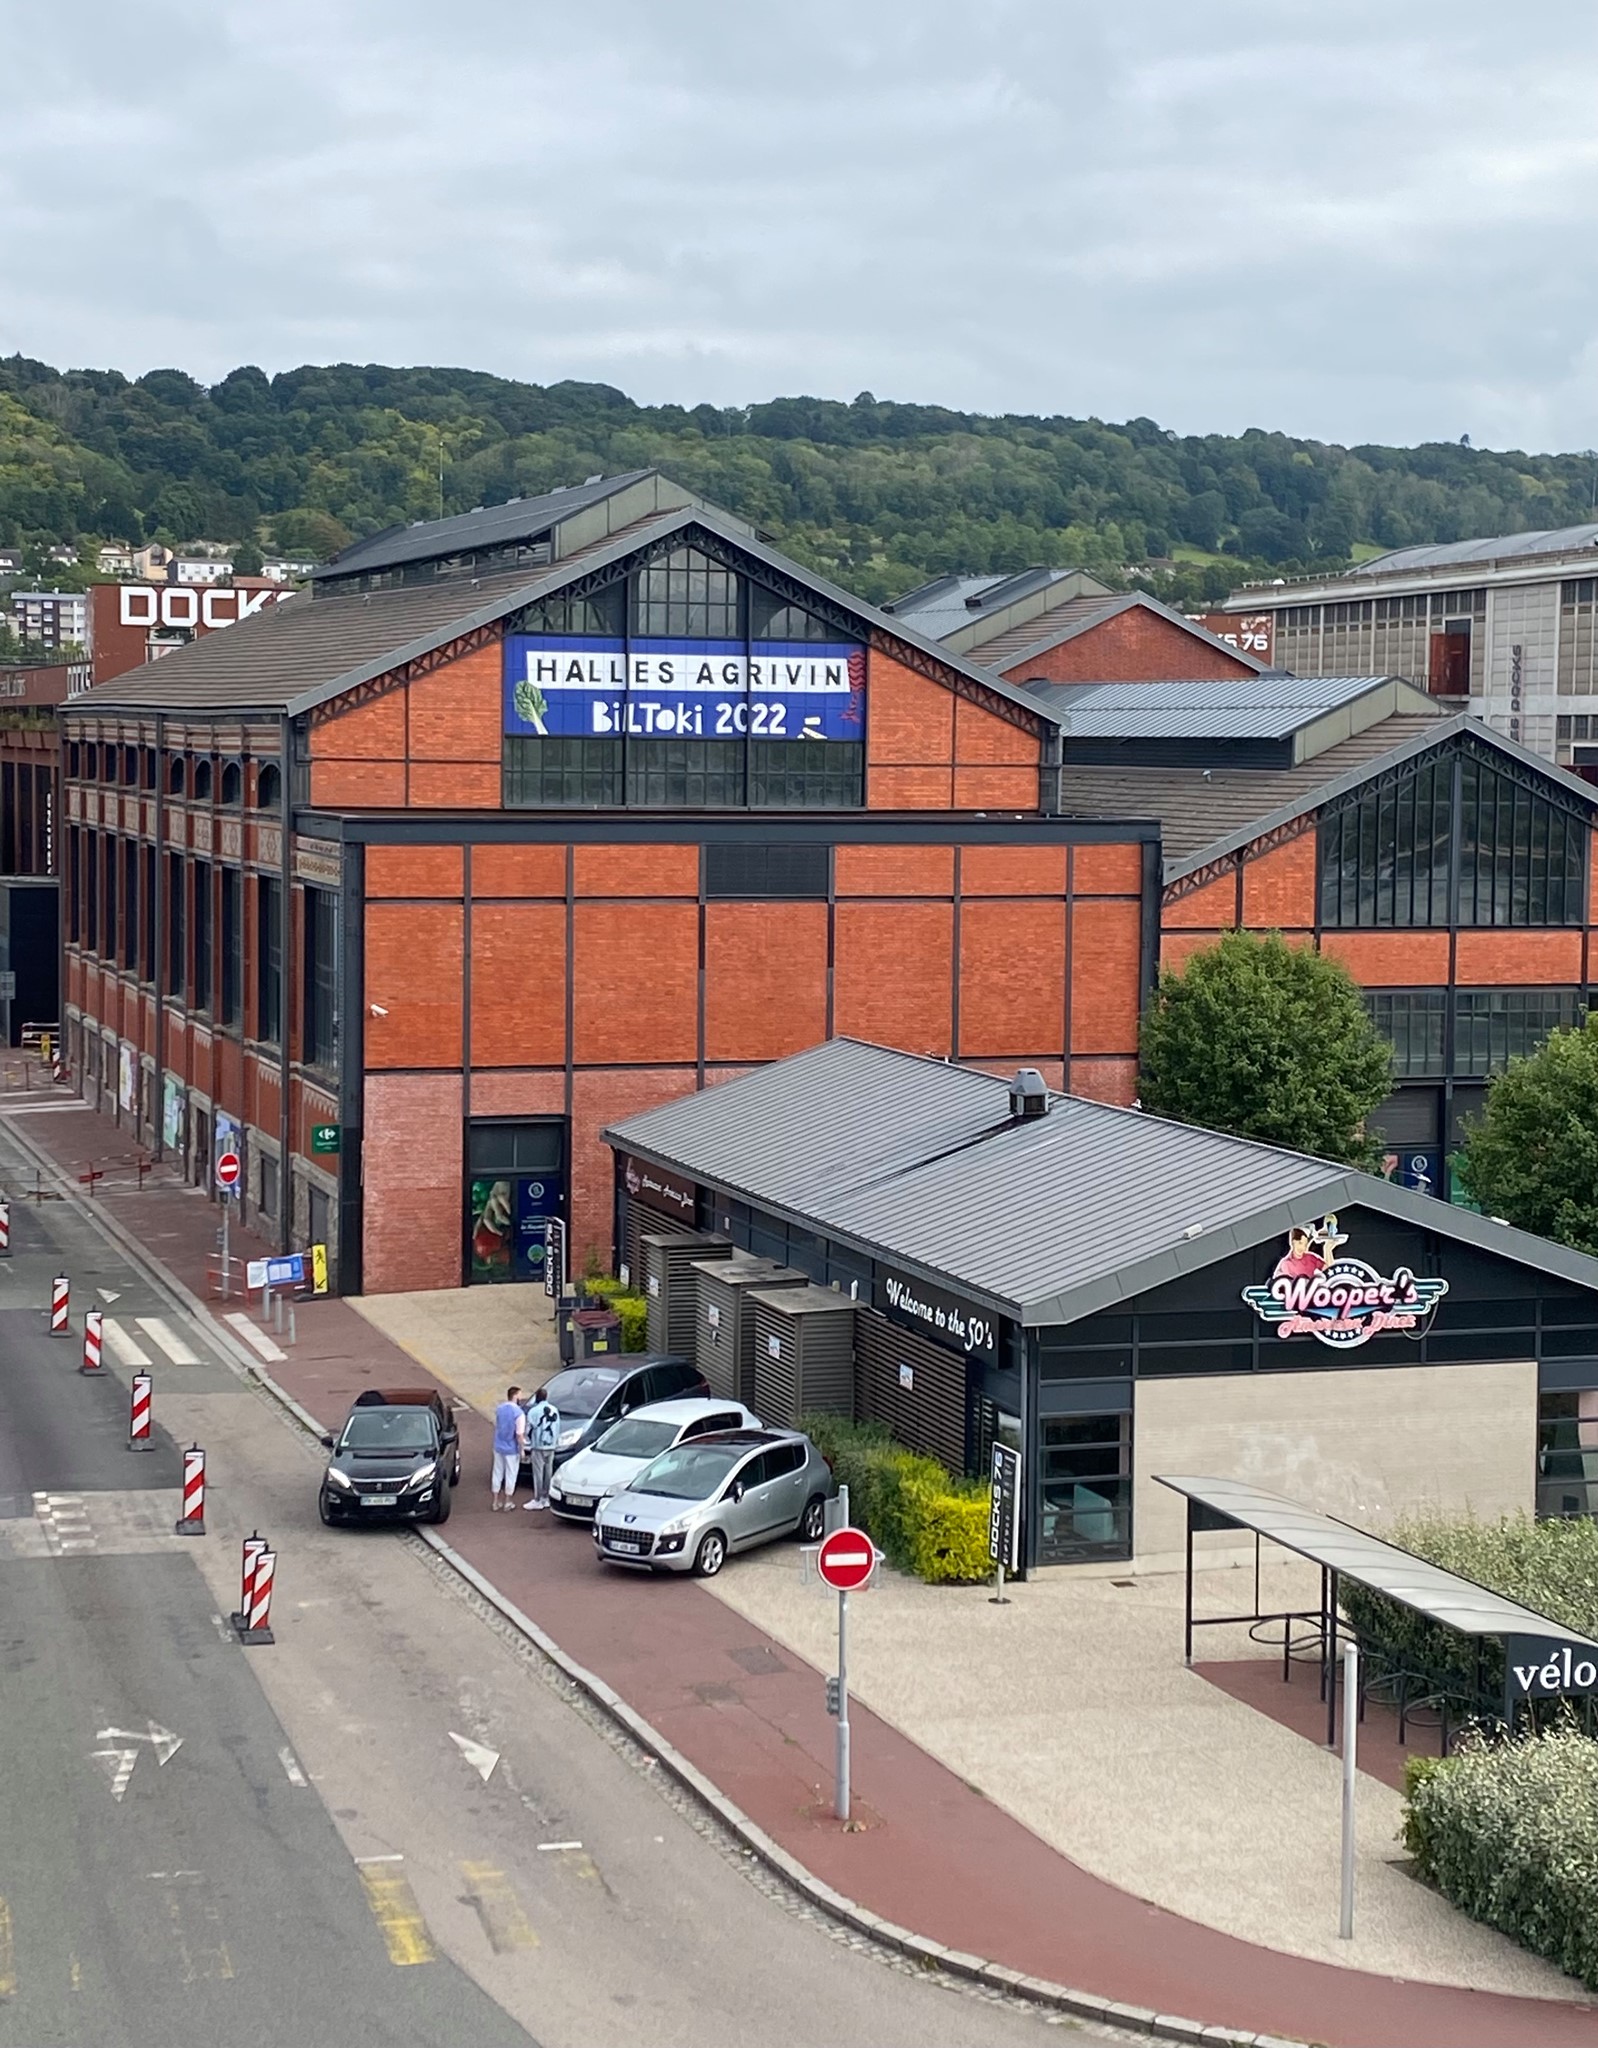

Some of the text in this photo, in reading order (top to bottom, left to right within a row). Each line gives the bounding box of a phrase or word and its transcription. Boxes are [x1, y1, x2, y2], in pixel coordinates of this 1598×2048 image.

[1240, 634, 1268, 651] 76
[536, 658, 842, 686] HALLES AGRIVIN
[1510, 644, 1522, 743] ES DOCKS
[715, 702, 787, 735] 2022
[546, 1245, 554, 1296] DOCKS
[886, 1277, 994, 1351] Welcome to the 50's
[1271, 1274, 1418, 1319] Wooper's
[1277, 1311, 1416, 1339] American Diner
[990, 1484, 1002, 1559] DOCKS
[1512, 1647, 1597, 1691] vélo
